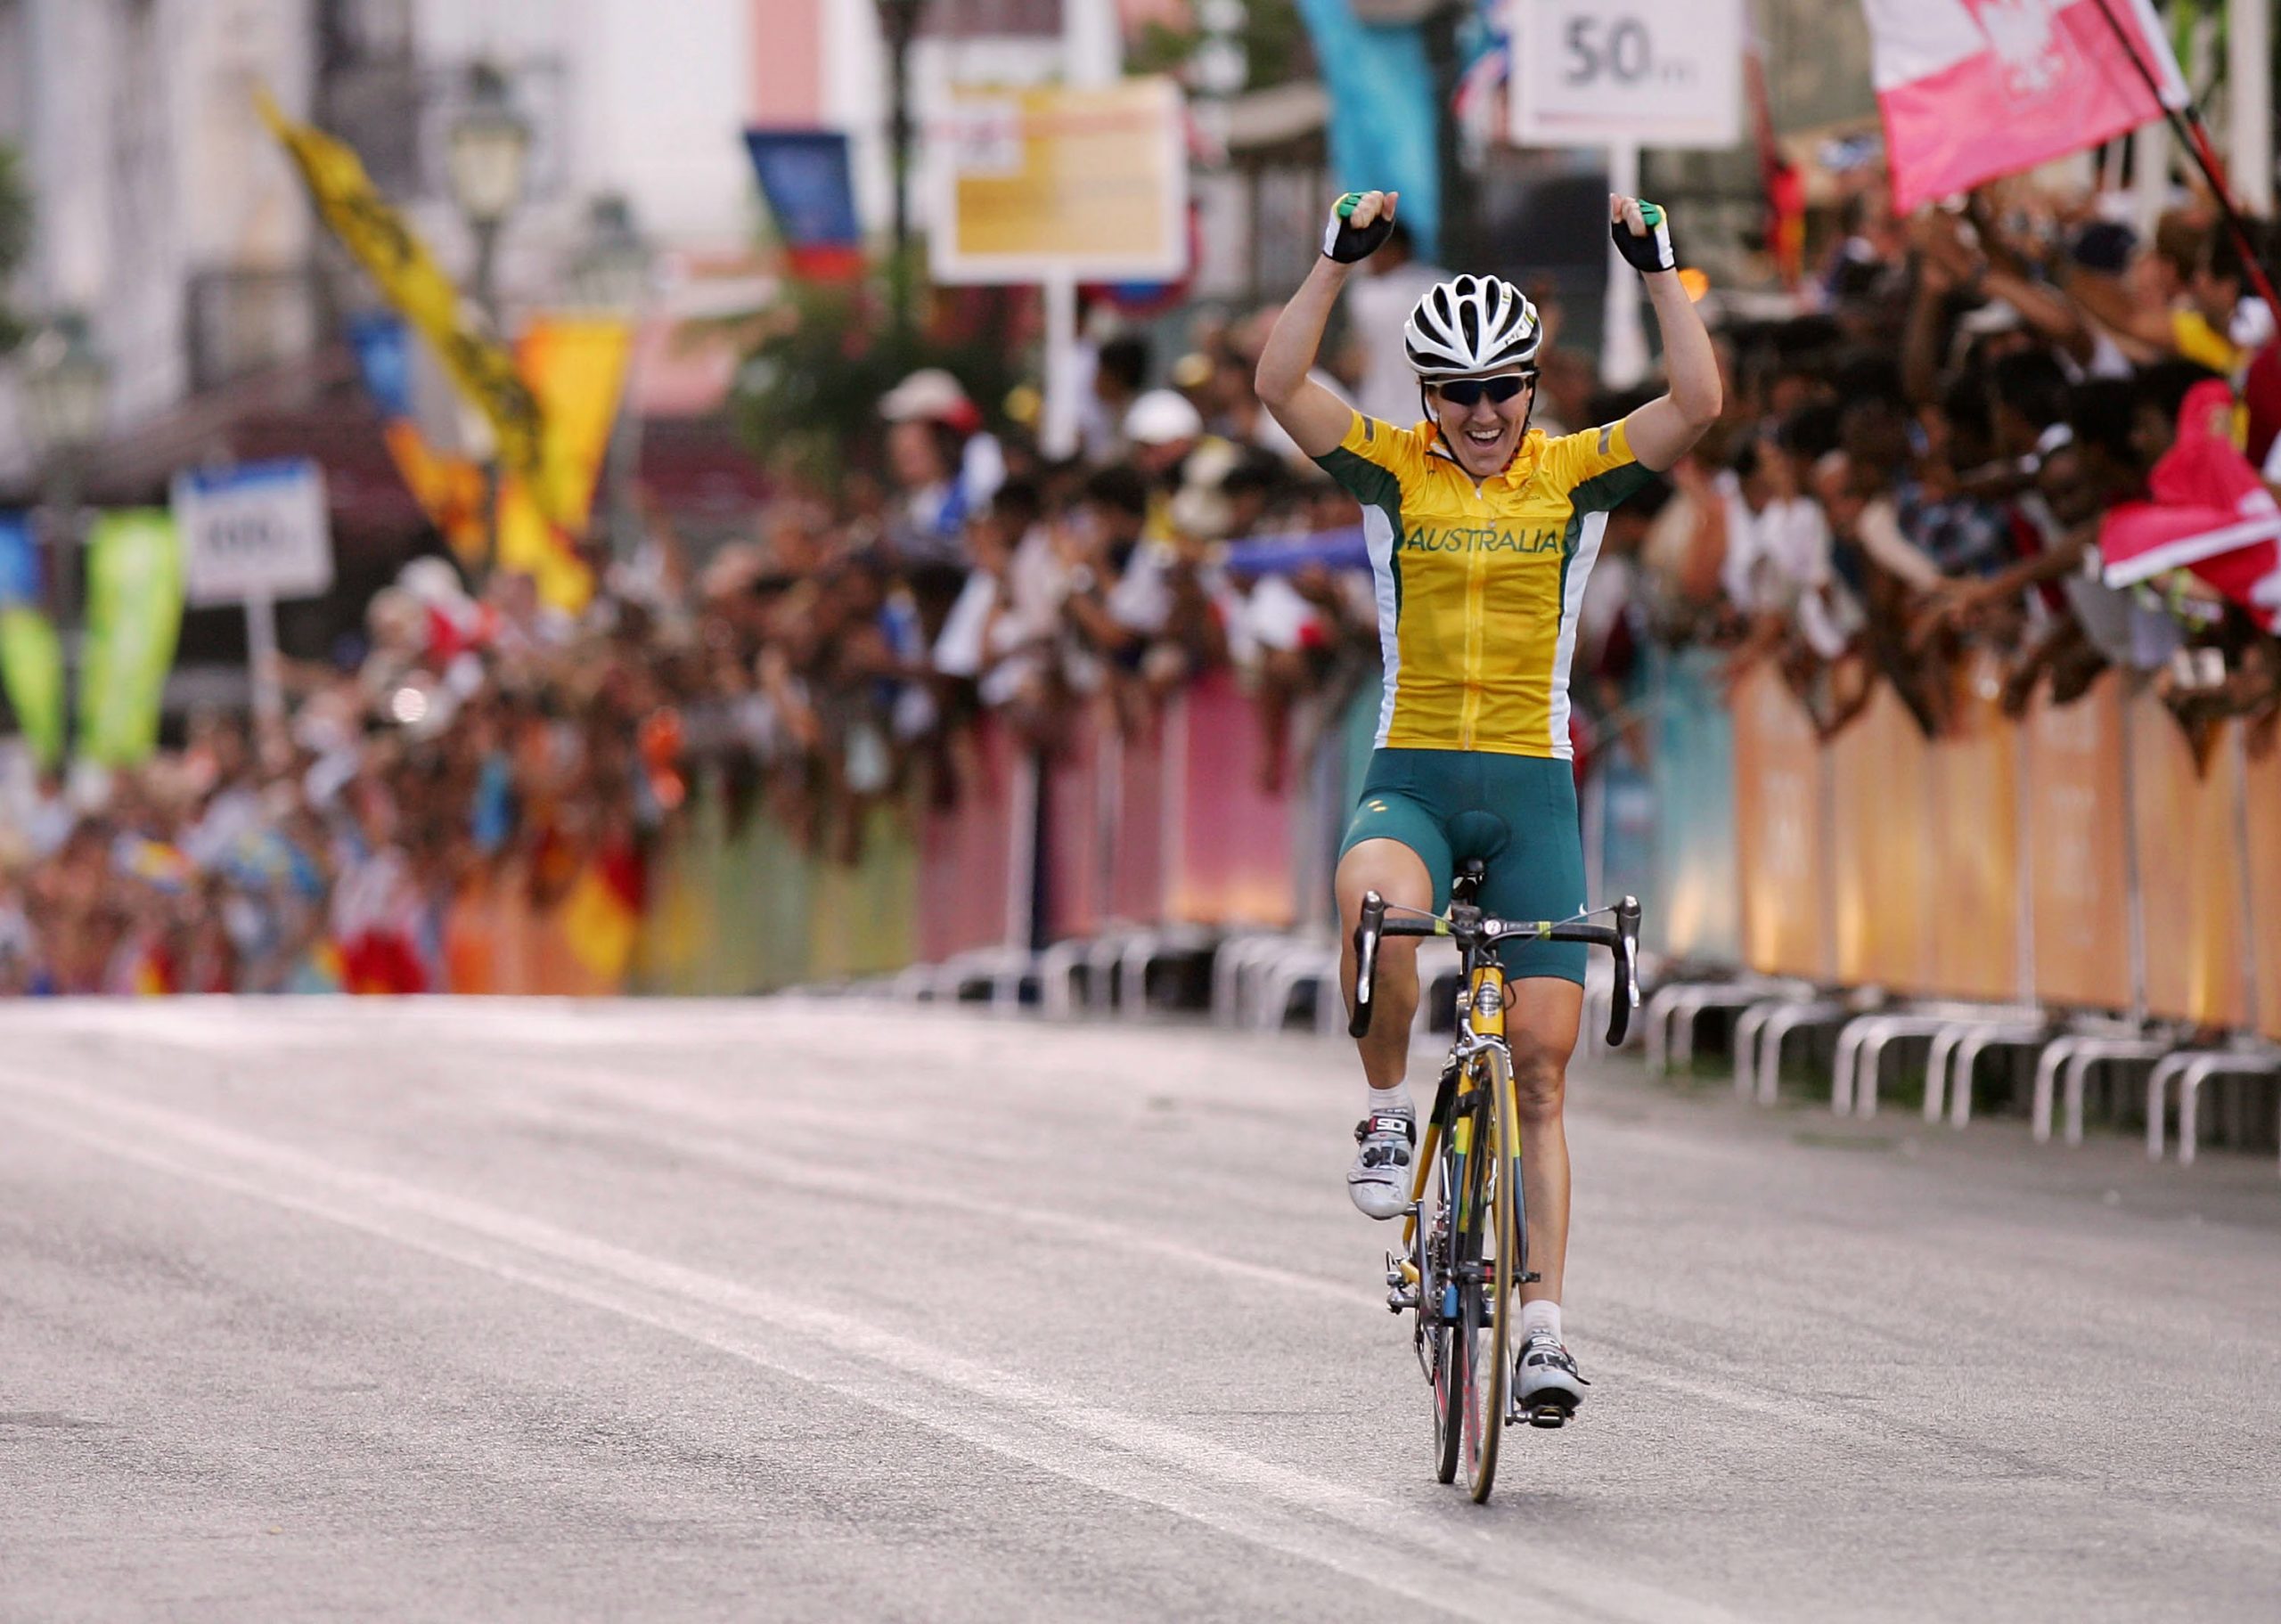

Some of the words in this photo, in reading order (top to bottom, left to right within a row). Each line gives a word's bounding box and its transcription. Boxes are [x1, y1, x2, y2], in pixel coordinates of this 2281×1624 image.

[1563, 16, 1650, 86] 50
[1408, 526, 1558, 554] AUSTRALIA
[1376, 1118, 1408, 1133] SIDI
